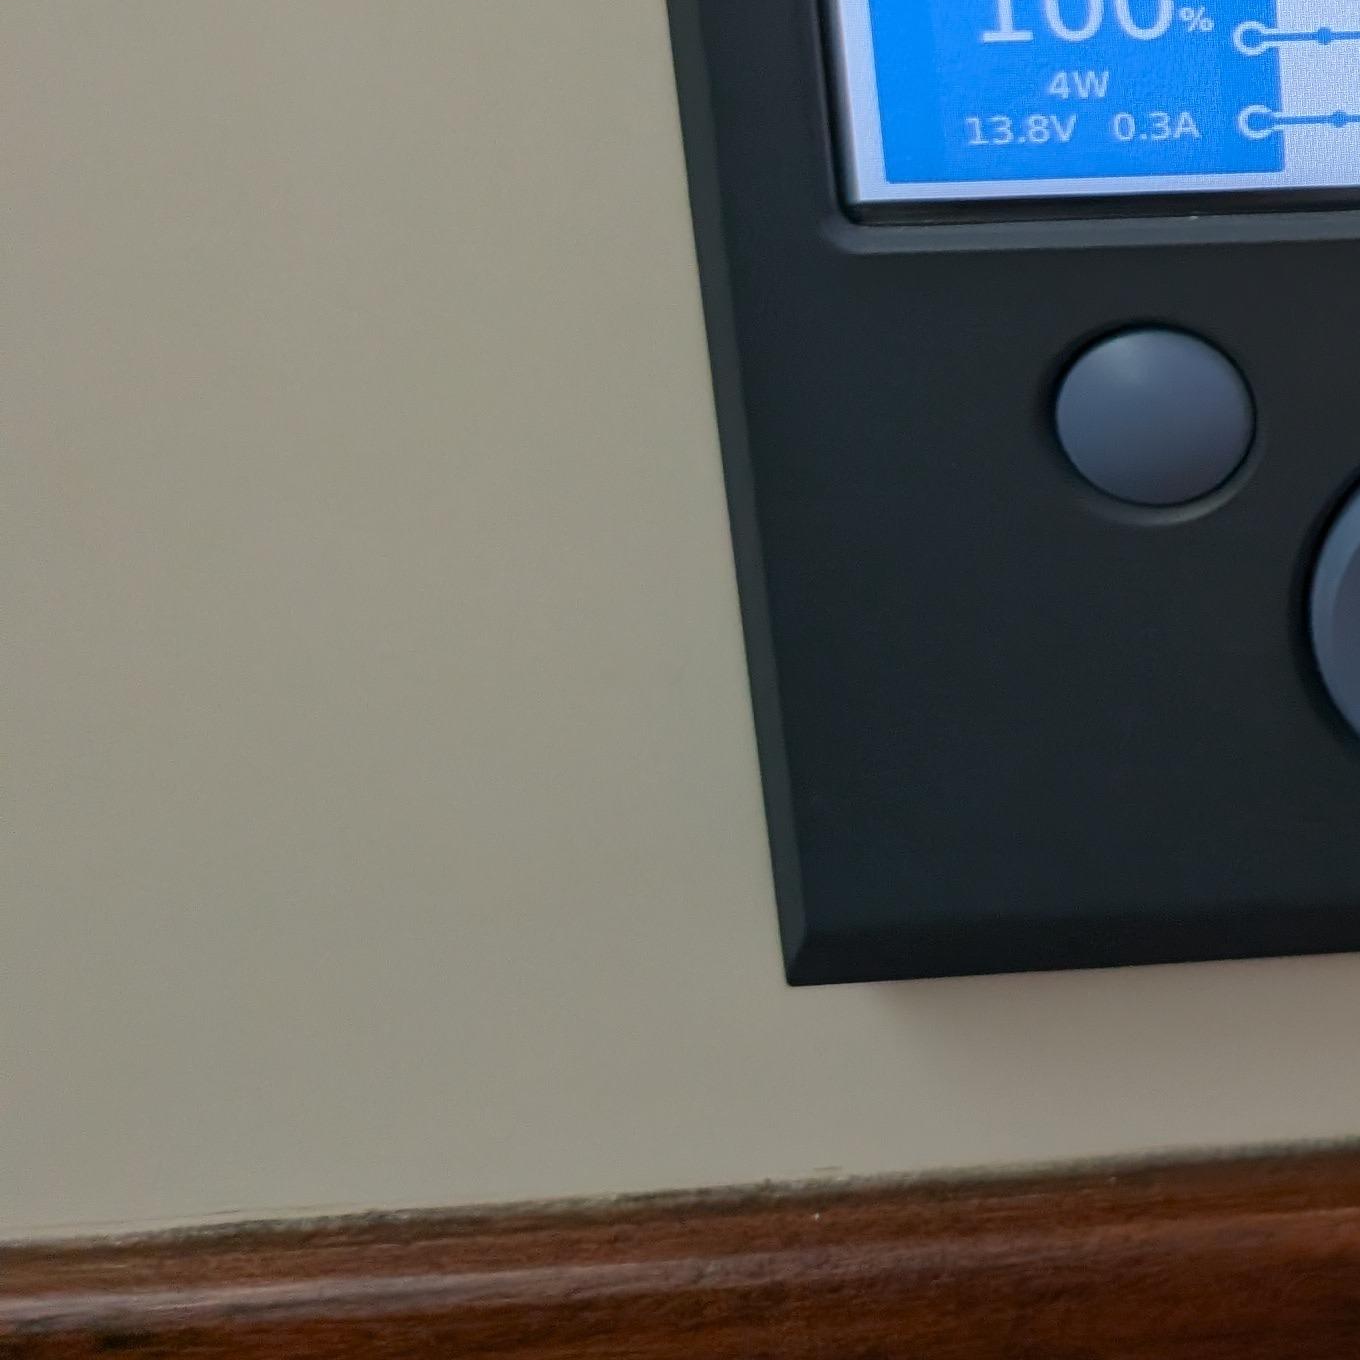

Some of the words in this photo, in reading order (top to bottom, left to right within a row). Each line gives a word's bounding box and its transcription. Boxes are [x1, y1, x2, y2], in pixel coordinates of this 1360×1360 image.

[1047, 70, 1111, 100] 4W
[964, 113, 1076, 147] 13.8V
[1113, 112, 1201, 144] 0.3A
